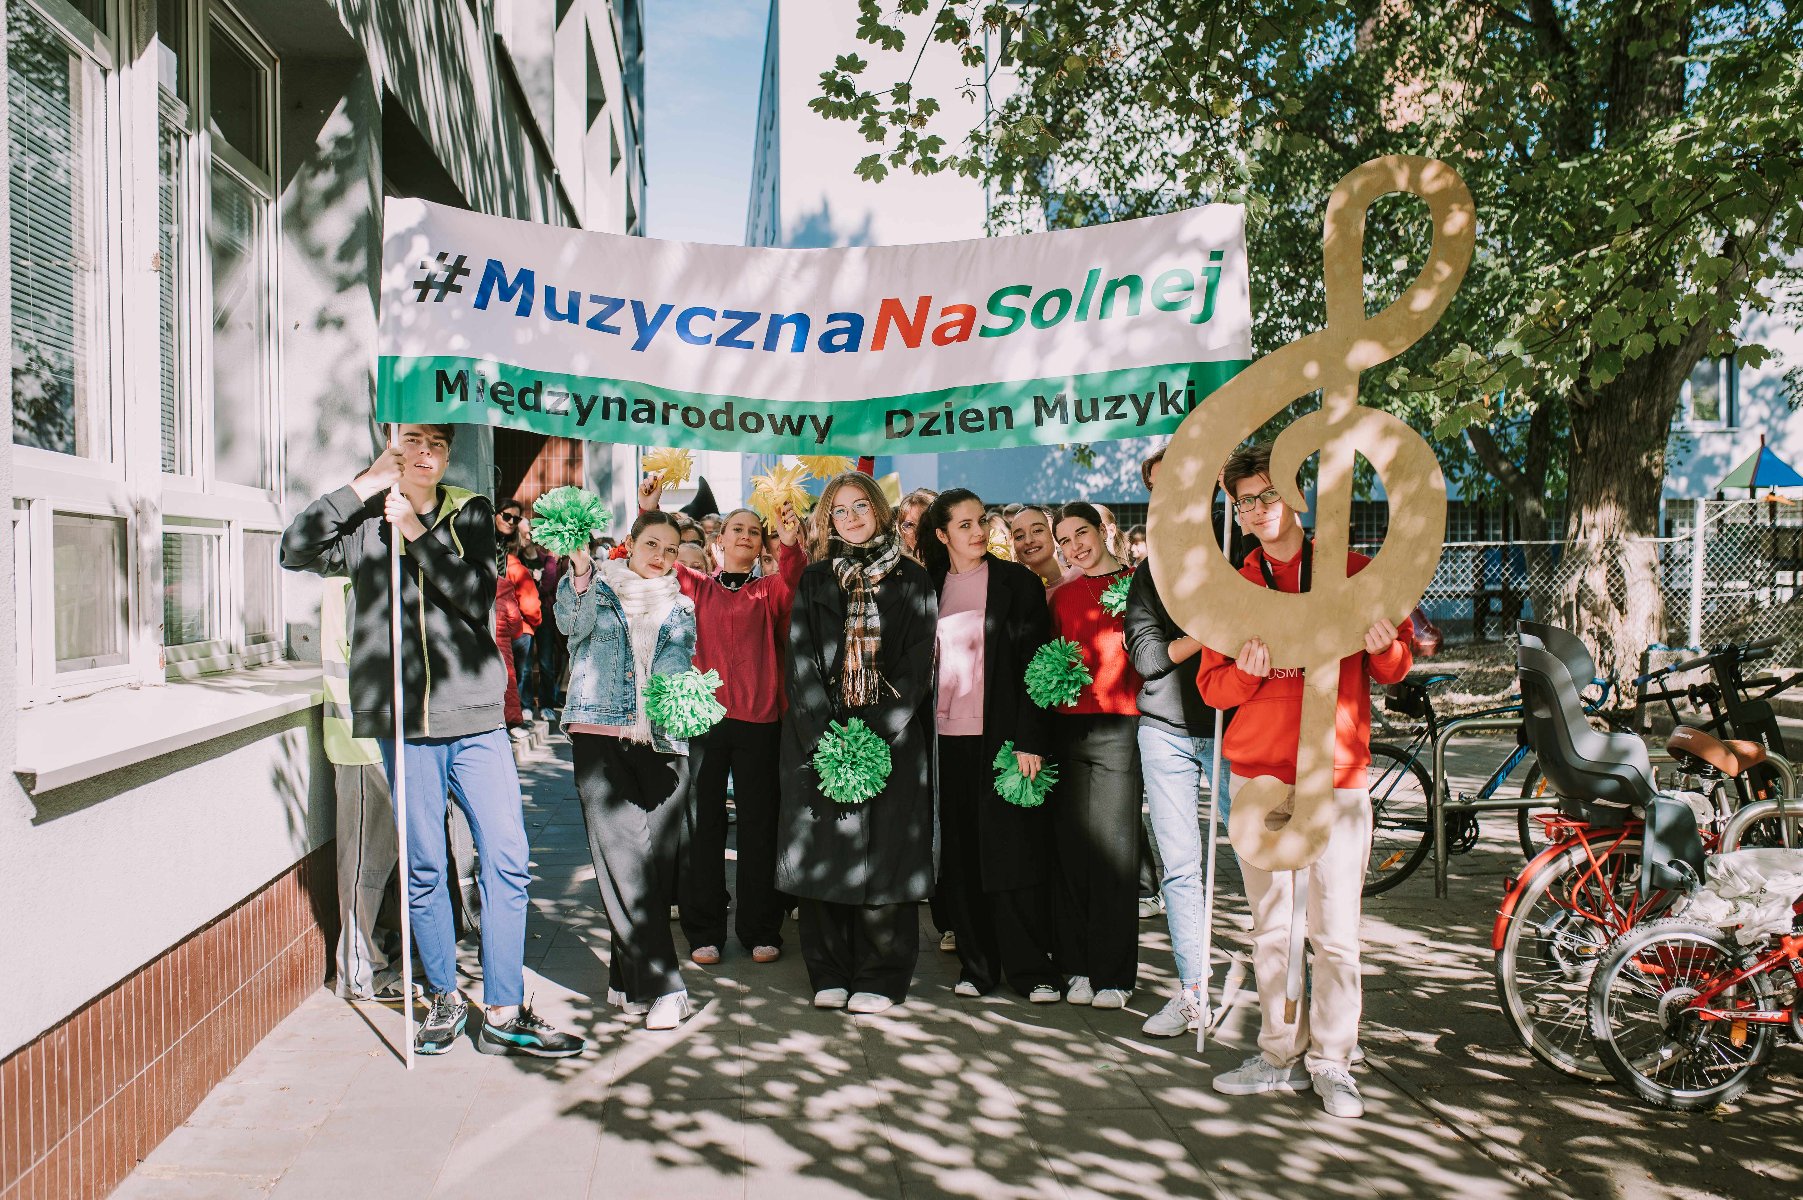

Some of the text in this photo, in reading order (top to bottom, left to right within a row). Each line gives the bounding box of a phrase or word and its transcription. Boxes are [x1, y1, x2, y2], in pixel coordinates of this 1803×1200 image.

[412, 250, 1225, 353] #MuzycznaNaSolnej
[434, 369, 1197, 444] Międzynarodowy Dzien Muzyki
